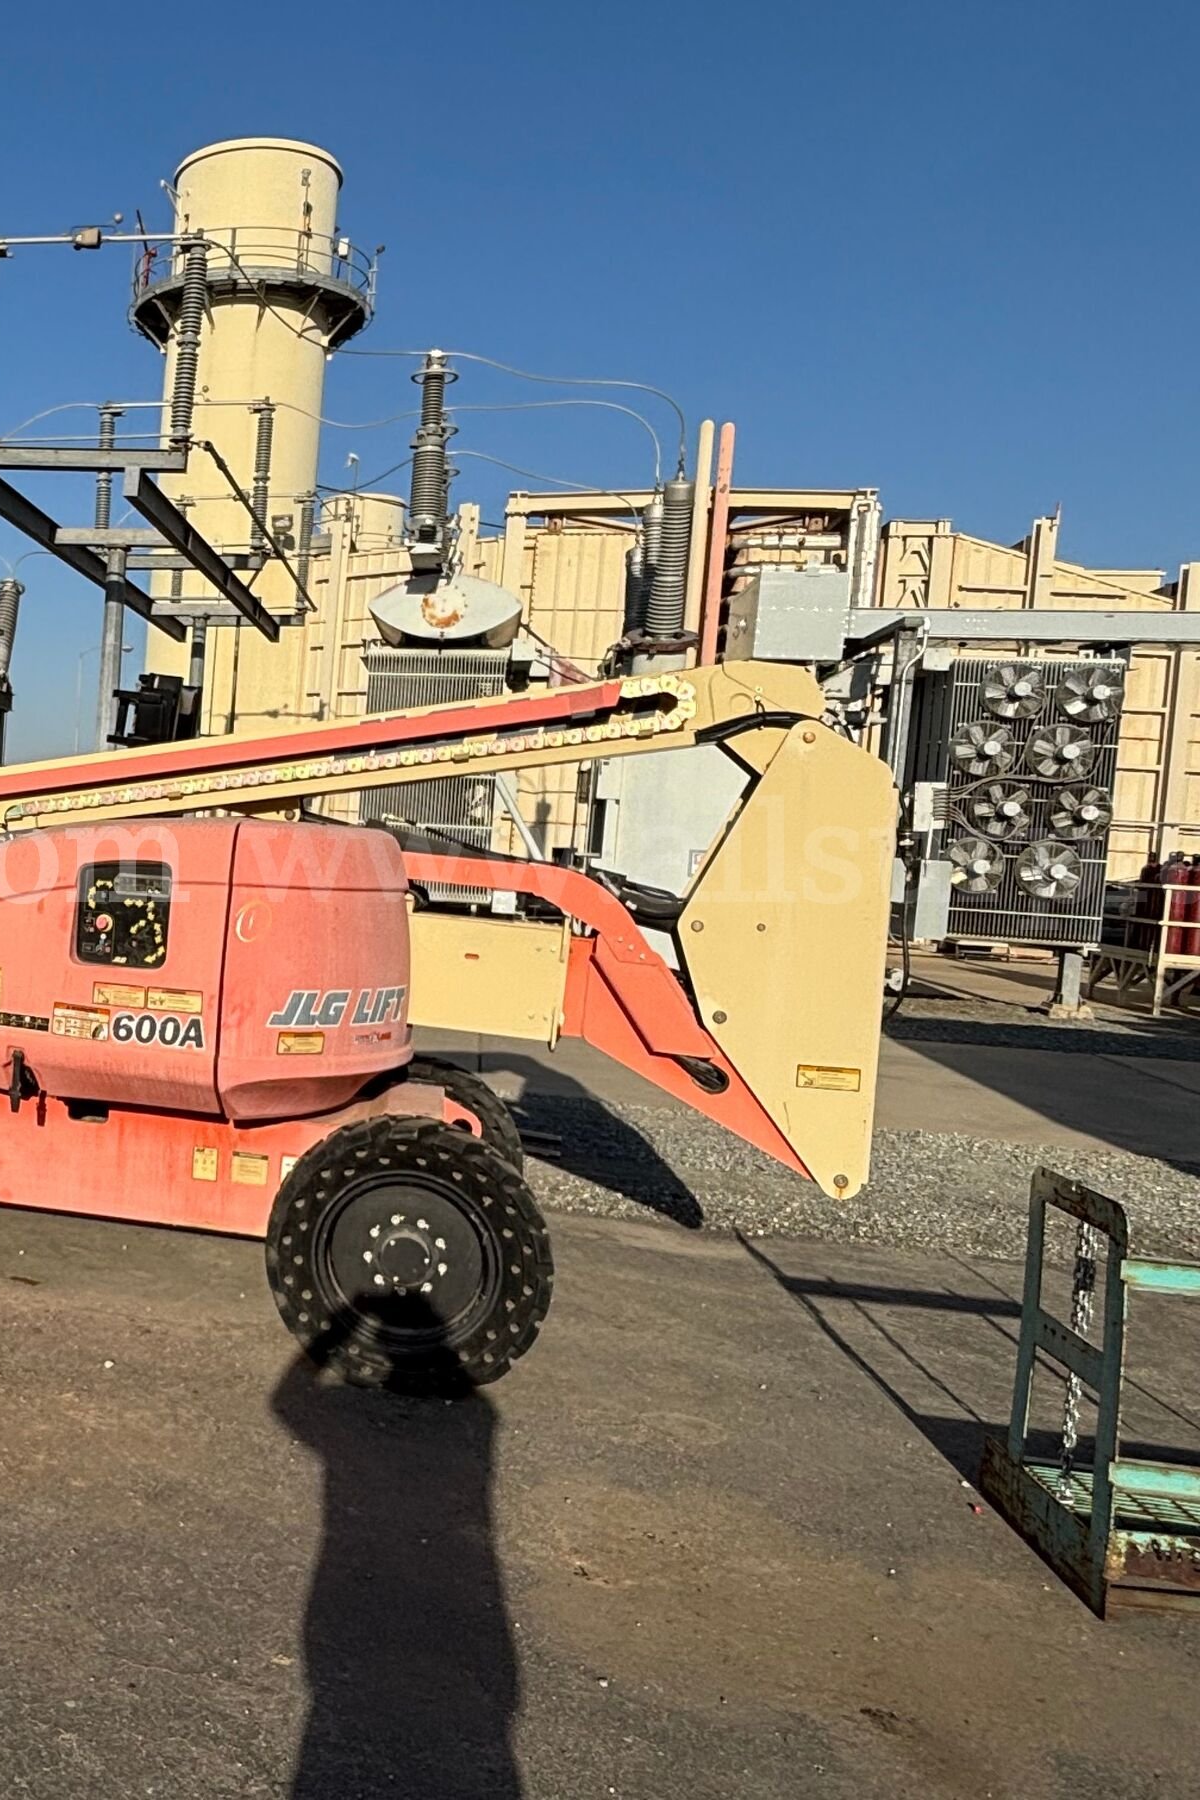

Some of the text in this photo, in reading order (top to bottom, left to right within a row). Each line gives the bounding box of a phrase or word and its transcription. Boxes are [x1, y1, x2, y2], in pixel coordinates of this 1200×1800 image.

[268, 985, 406, 1026] JLG LIFT
[111, 1012, 204, 1049] 600A
